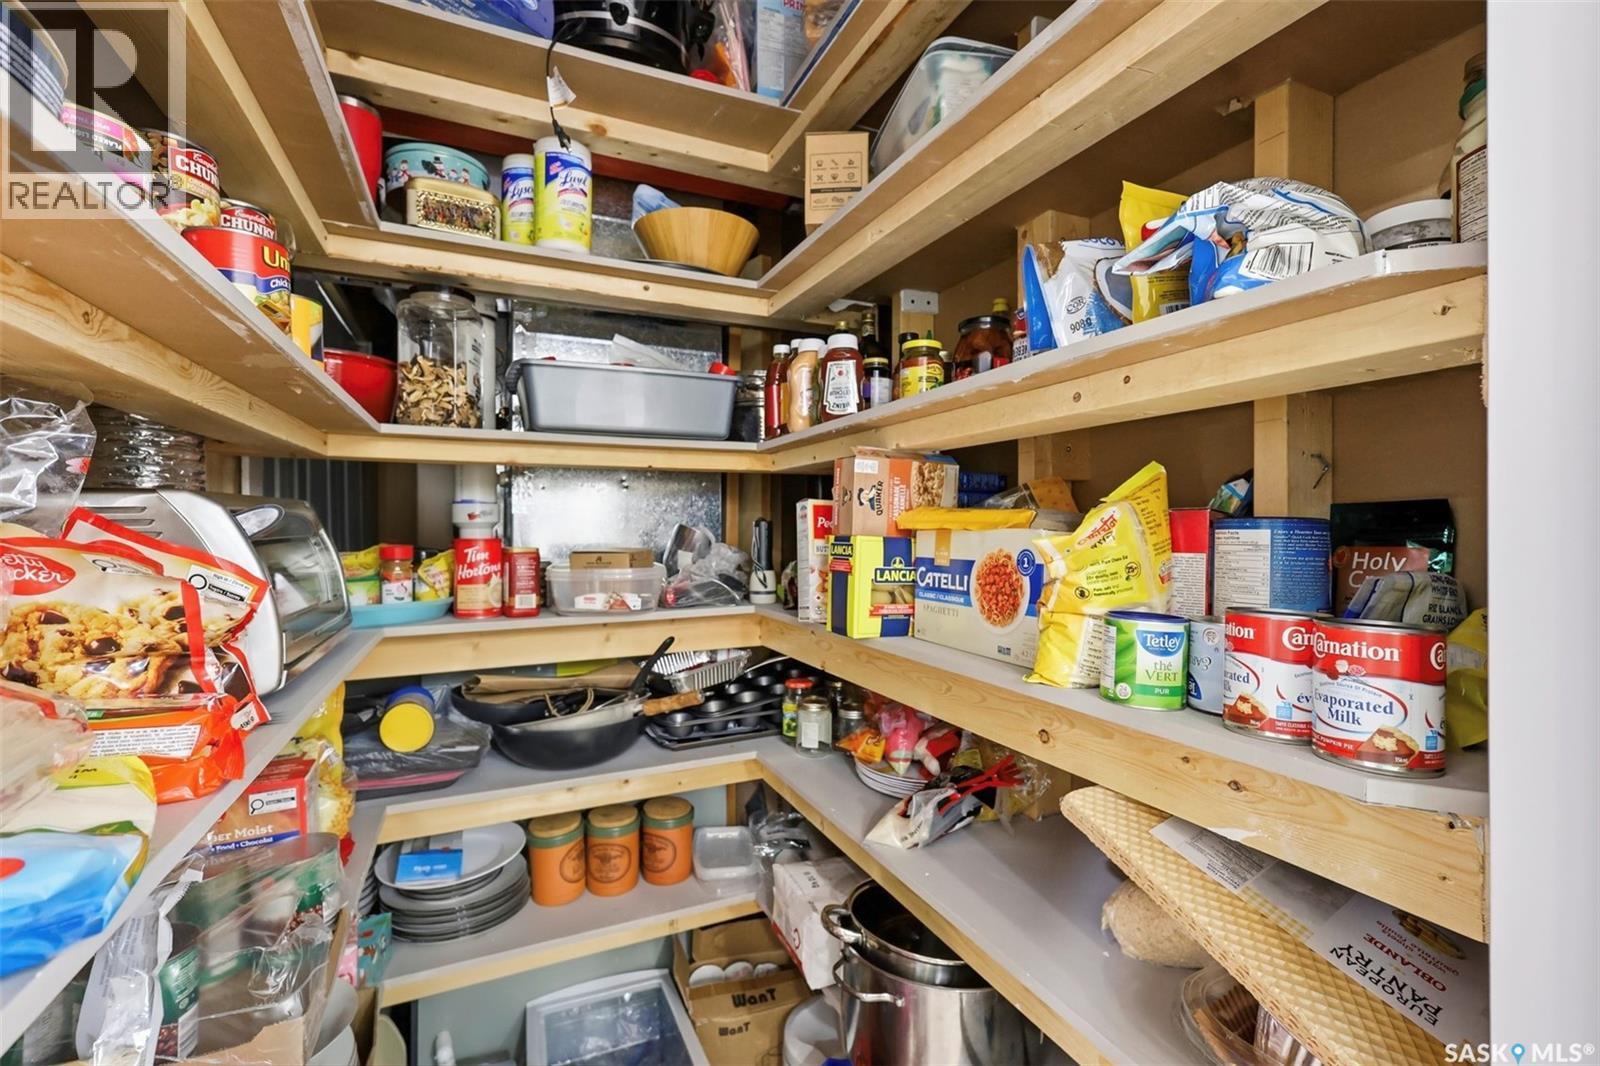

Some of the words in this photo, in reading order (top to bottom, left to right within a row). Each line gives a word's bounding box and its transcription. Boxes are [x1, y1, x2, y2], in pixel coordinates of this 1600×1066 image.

[220, 214, 275, 239] CHUNKY
[876, 480, 884, 516] QUAKER
[464, 546, 490, 561] Tim
[1352, 552, 1407, 571] Holy
[876, 570, 917, 582] LANCIA
[916, 566, 969, 591] CATELLI
[1143, 633, 1180, 652] Tetley
[1313, 632, 1401, 662] Carnation
[1154, 660, 1172, 671] thé
[1145, 670, 1179, 682] VERT
[1314, 688, 1394, 715] Evaporated
[1328, 707, 1361, 726] Milk
[234, 823, 275, 838] Moist
[1363, 932, 1447, 992] OBLANDE
[1329, 947, 1438, 1026] EUROPEAN
[1338, 943, 1443, 1016] PANTRY
[731, 988, 777, 1008] WanT
[718, 1022, 751, 1037] WanT
